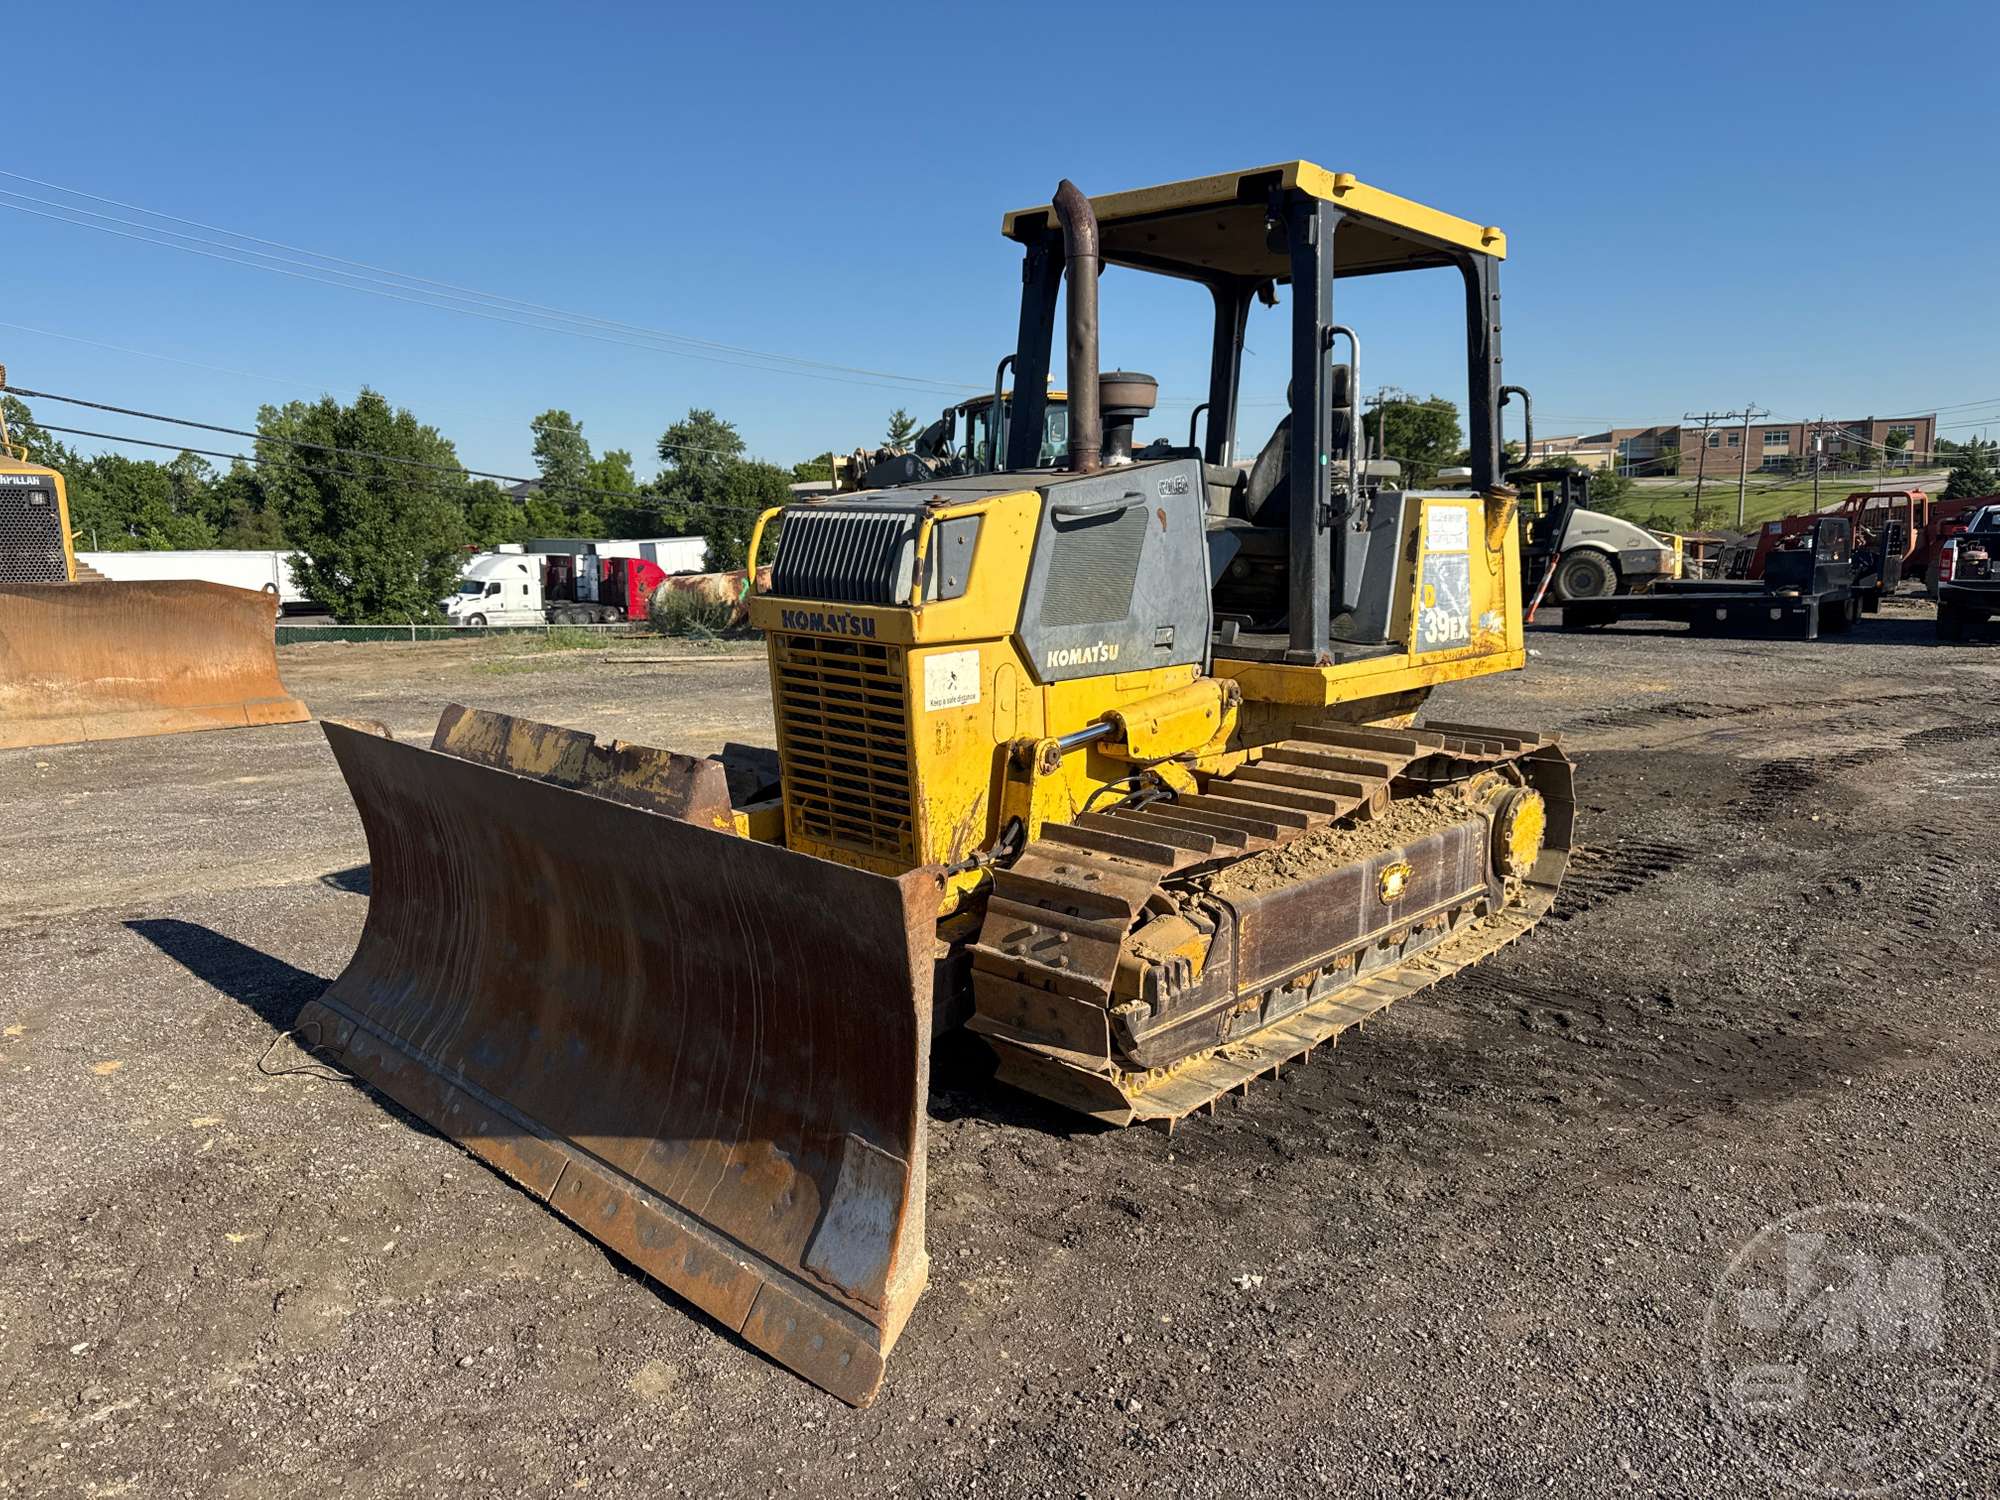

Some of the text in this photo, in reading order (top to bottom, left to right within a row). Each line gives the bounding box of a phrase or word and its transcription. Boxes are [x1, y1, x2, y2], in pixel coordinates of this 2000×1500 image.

[781, 608, 876, 638] KOMATSU
[1424, 609, 1469, 643] 39EX
[1046, 640, 1119, 668] KOMATSU
[930, 698, 942, 706] Keep
[946, 696, 957, 705] safe
[957, 693, 976, 702] distance
